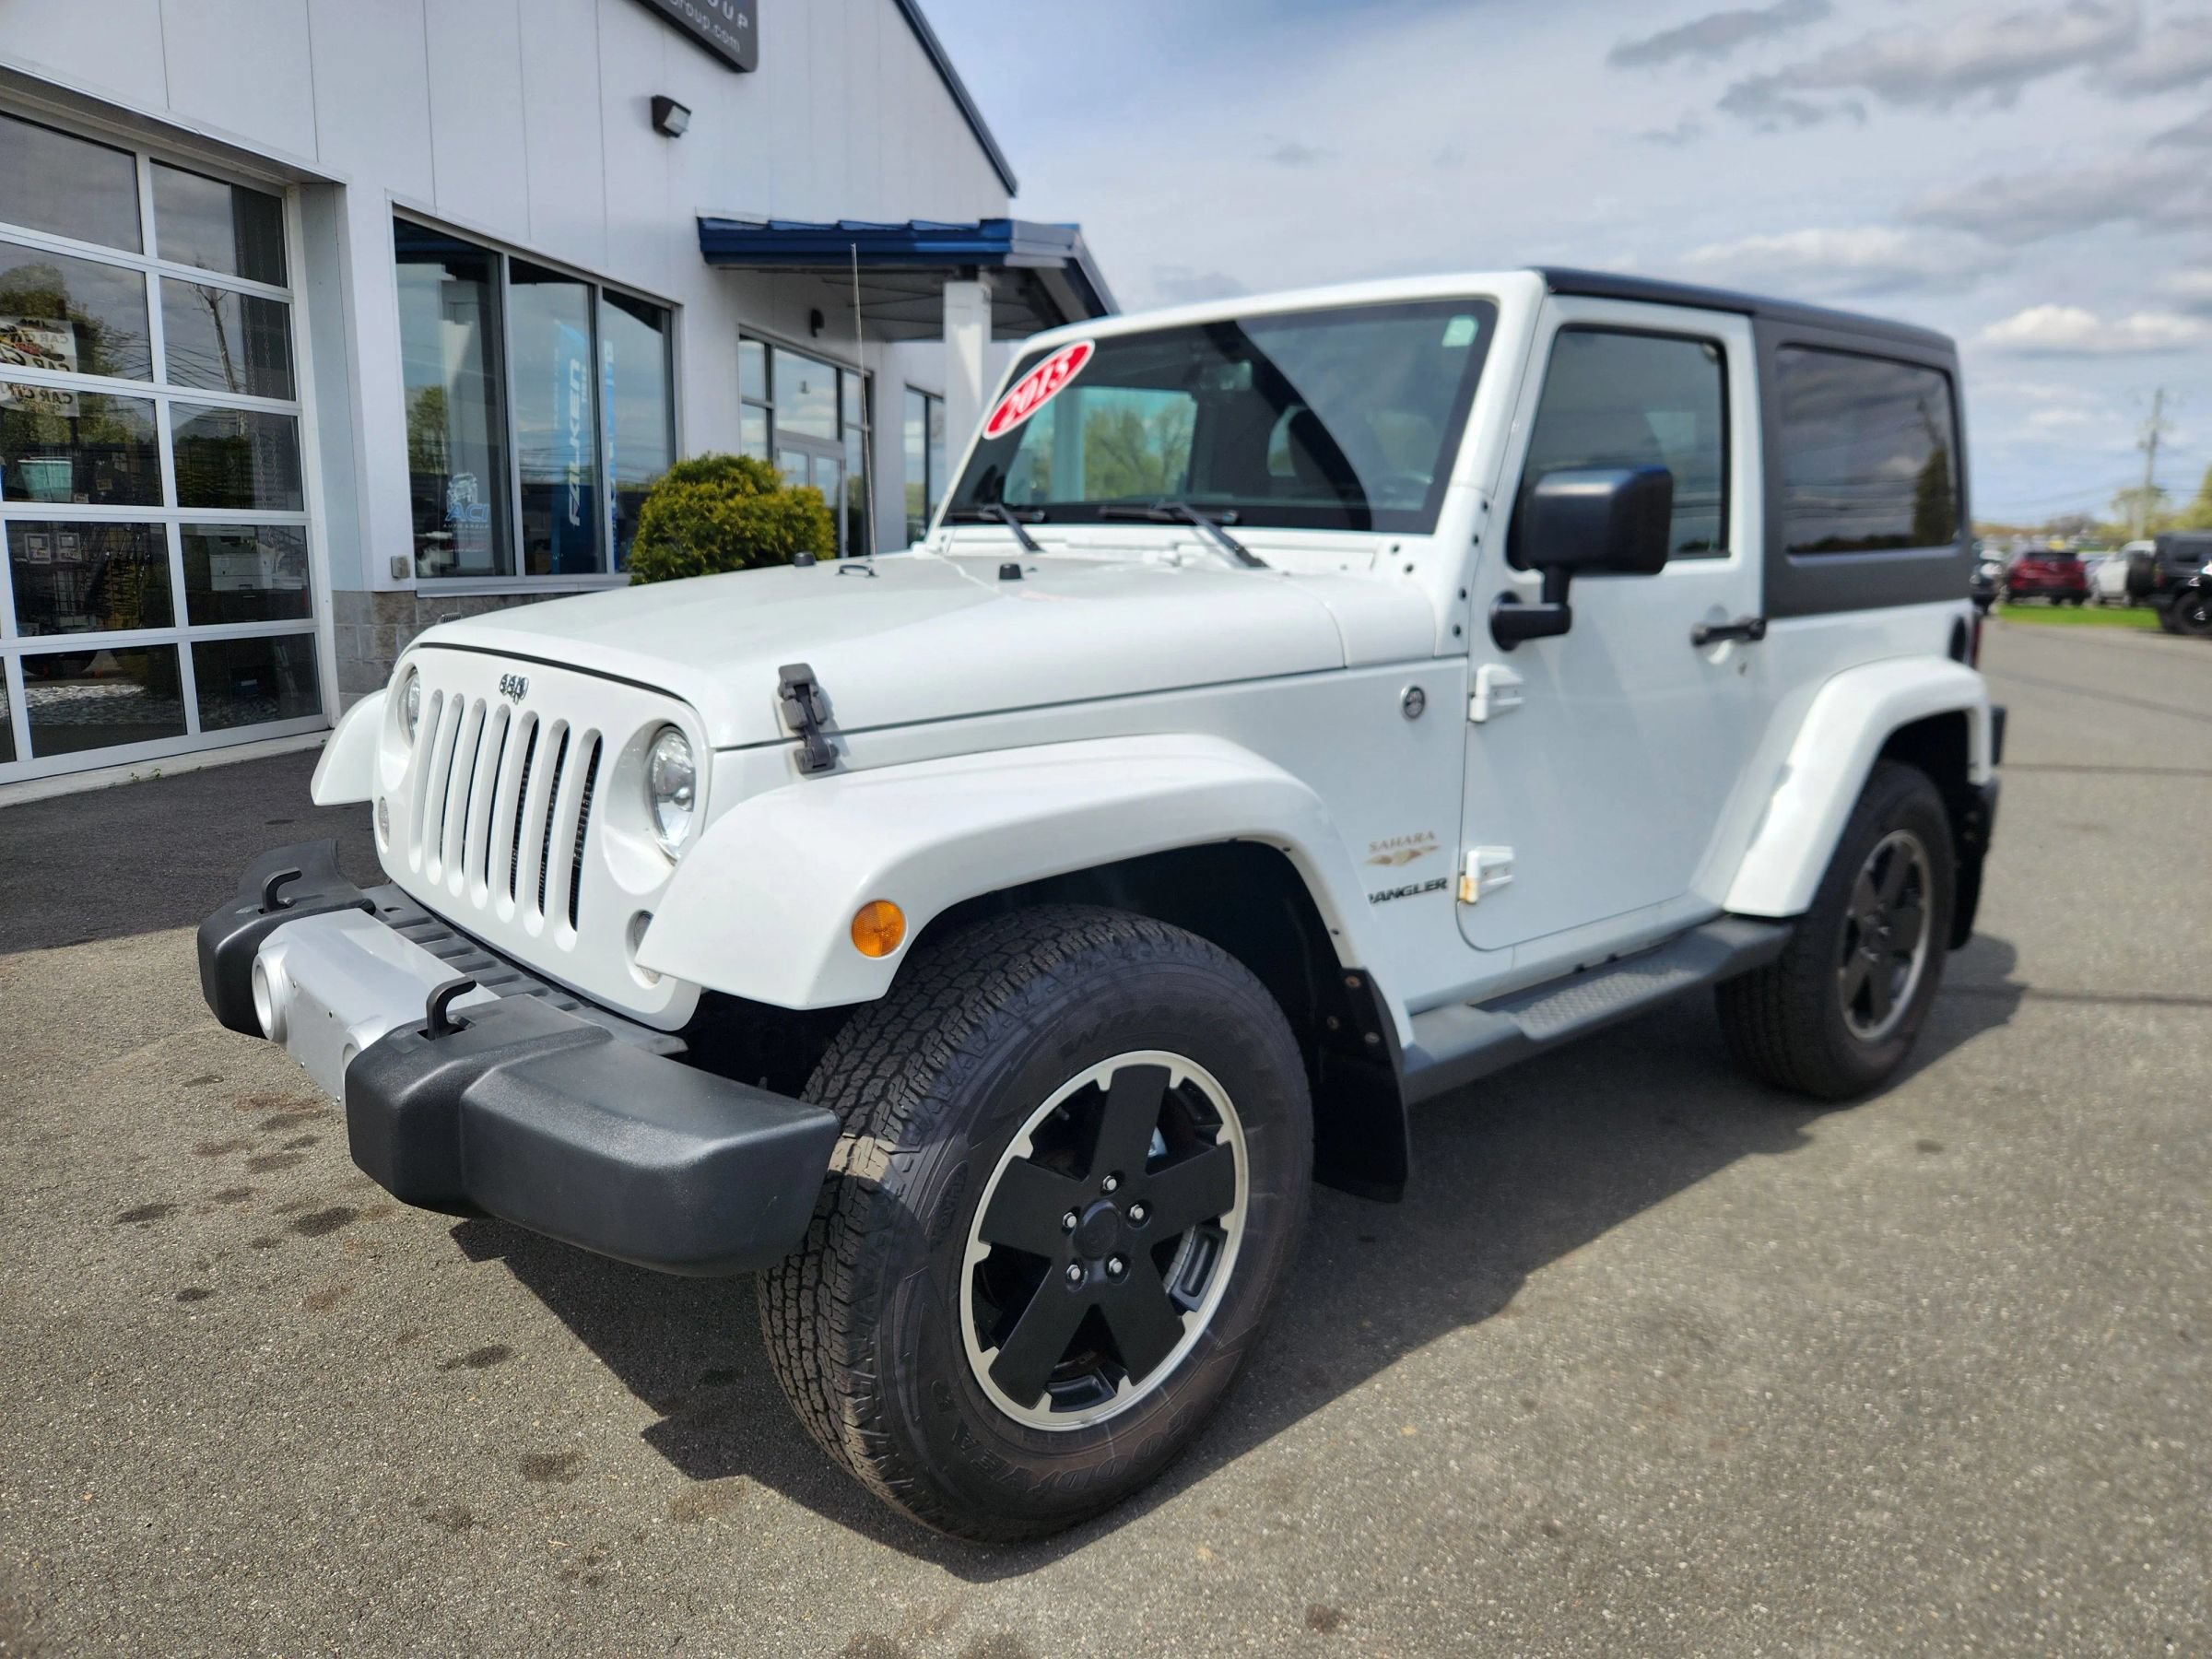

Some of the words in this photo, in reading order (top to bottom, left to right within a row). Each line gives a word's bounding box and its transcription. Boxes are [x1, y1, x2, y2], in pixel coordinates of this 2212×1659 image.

[998, 347, 1075, 430] 2015
[569, 358, 581, 527] FALKEN
[444, 502, 490, 524] ACI
[1370, 831, 1435, 852] SAHARA
[930, 1378, 1196, 1493] GOODYEAR
